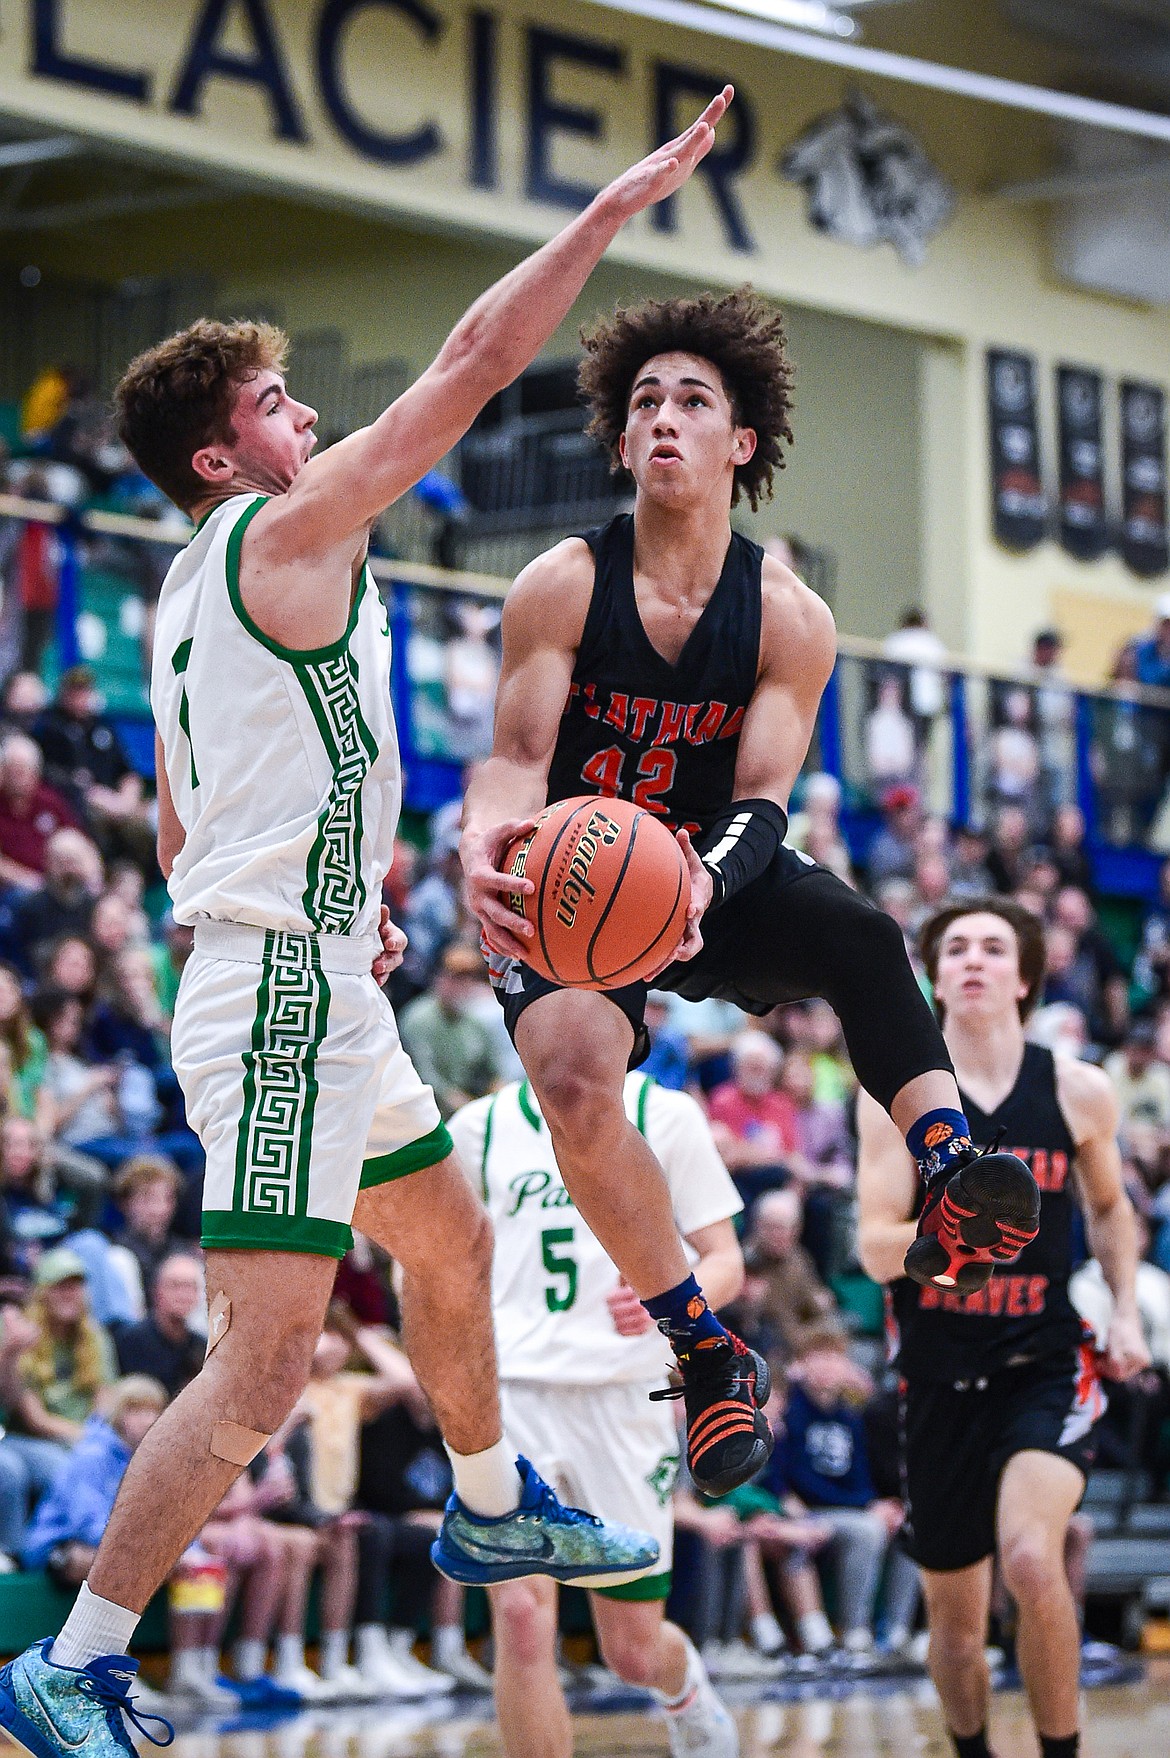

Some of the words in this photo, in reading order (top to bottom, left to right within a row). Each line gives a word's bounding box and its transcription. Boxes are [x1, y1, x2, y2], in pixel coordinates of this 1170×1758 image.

[580, 744, 678, 814] 42
[556, 809, 622, 929] Baden
[541, 1227, 578, 1313] 5
